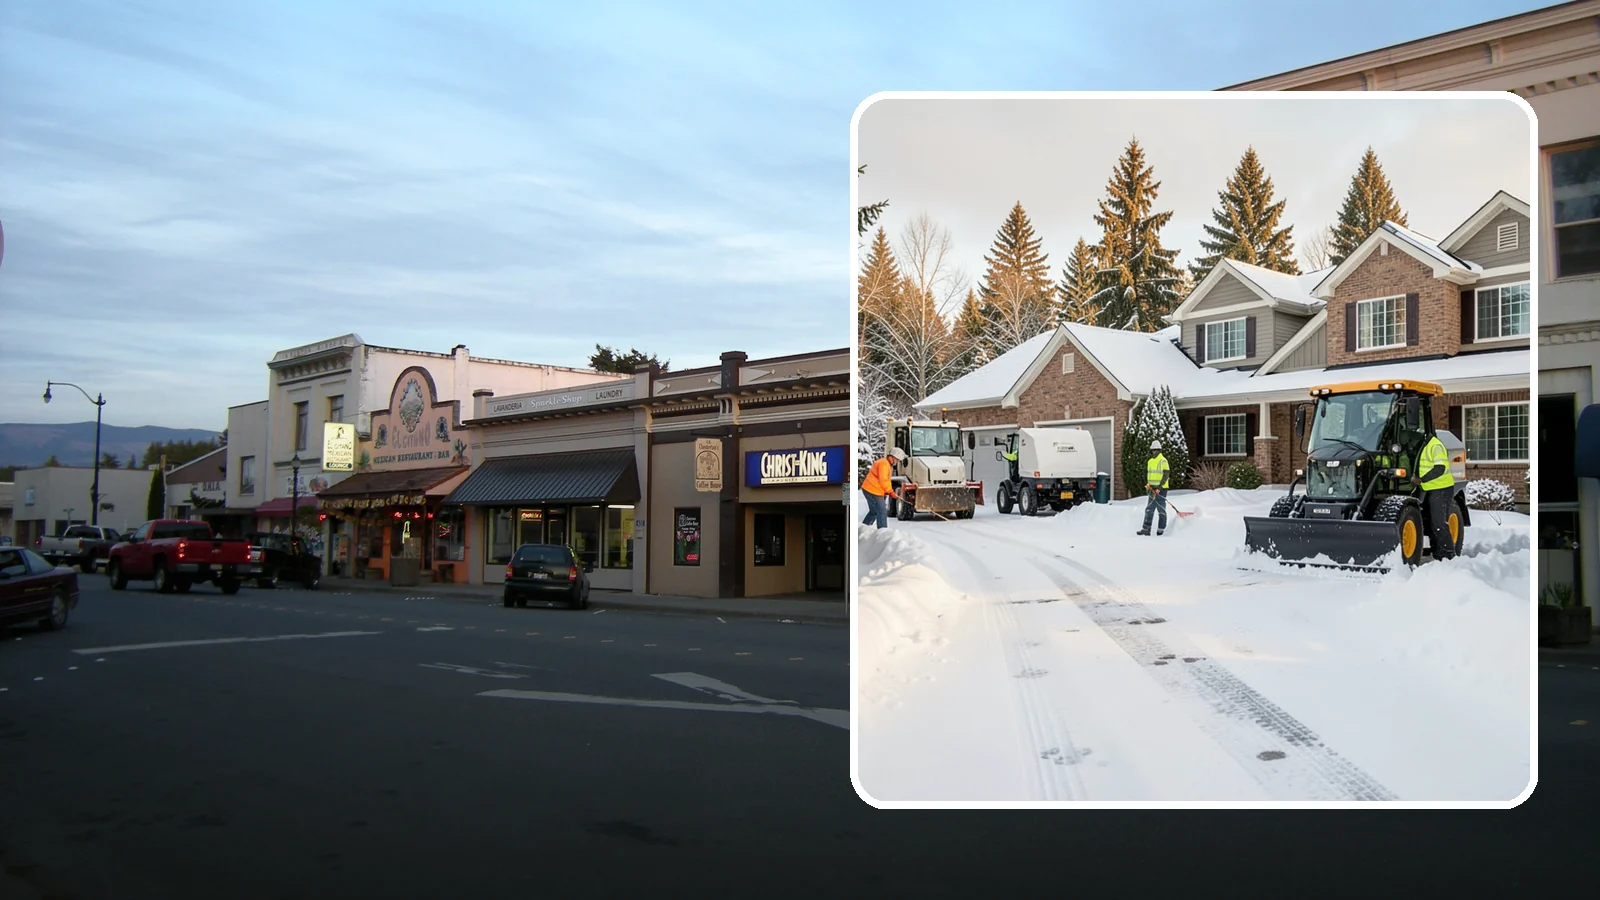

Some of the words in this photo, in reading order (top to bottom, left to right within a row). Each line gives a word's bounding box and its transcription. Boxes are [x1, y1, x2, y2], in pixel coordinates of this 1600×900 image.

[561, 394, 582, 405] Shop
[596, 389, 623, 400] LAUNDRY
[494, 402, 522, 413] LAVANDERIA
[397, 452, 433, 462] RESTAURANT
[438, 450, 450, 459] BAR
